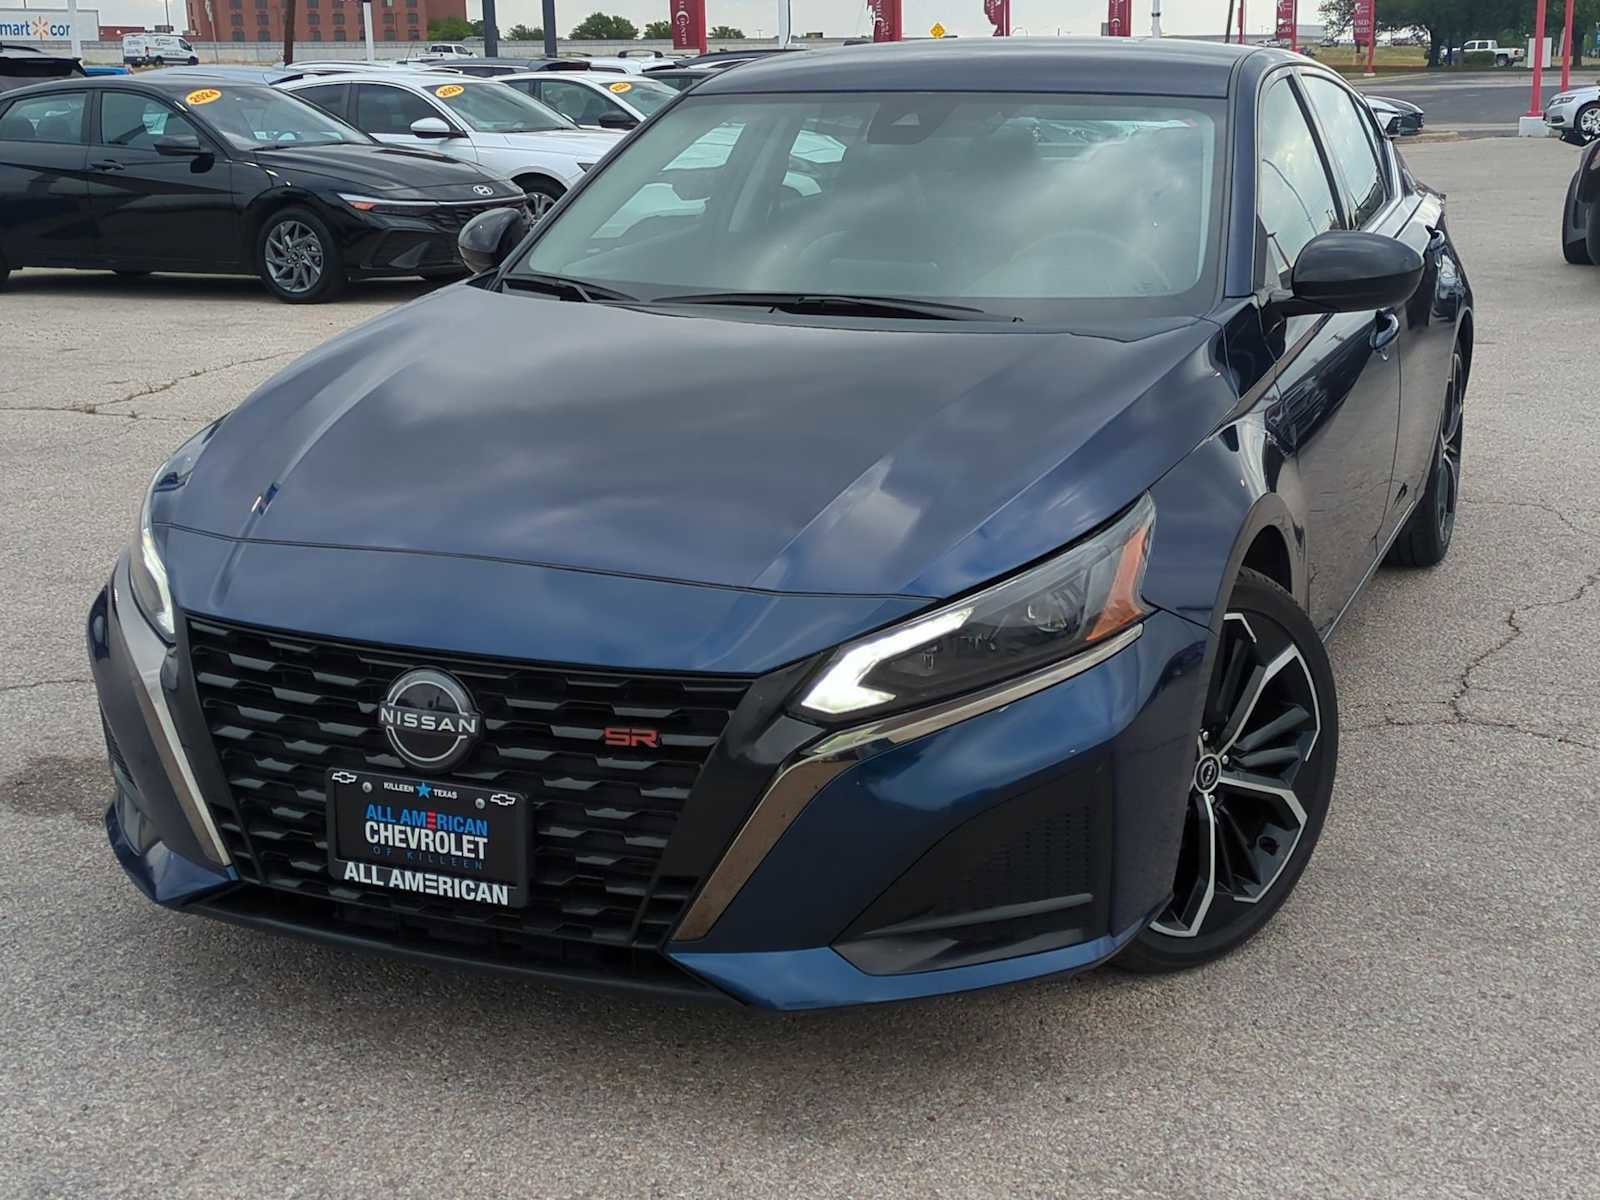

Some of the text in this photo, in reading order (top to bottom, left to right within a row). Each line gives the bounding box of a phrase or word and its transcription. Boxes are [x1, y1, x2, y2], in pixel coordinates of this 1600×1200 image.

[380, 707, 475, 733] NISSAN
[603, 727, 658, 748] SR
[383, 781, 458, 799] KILLEEN TEXAS
[365, 803, 488, 836] ALL AMERICAN
[364, 821, 488, 860] CHEVROLET
[372, 846, 483, 870] OF KILLEEN
[343, 861, 509, 906] ALL AMERICAN
